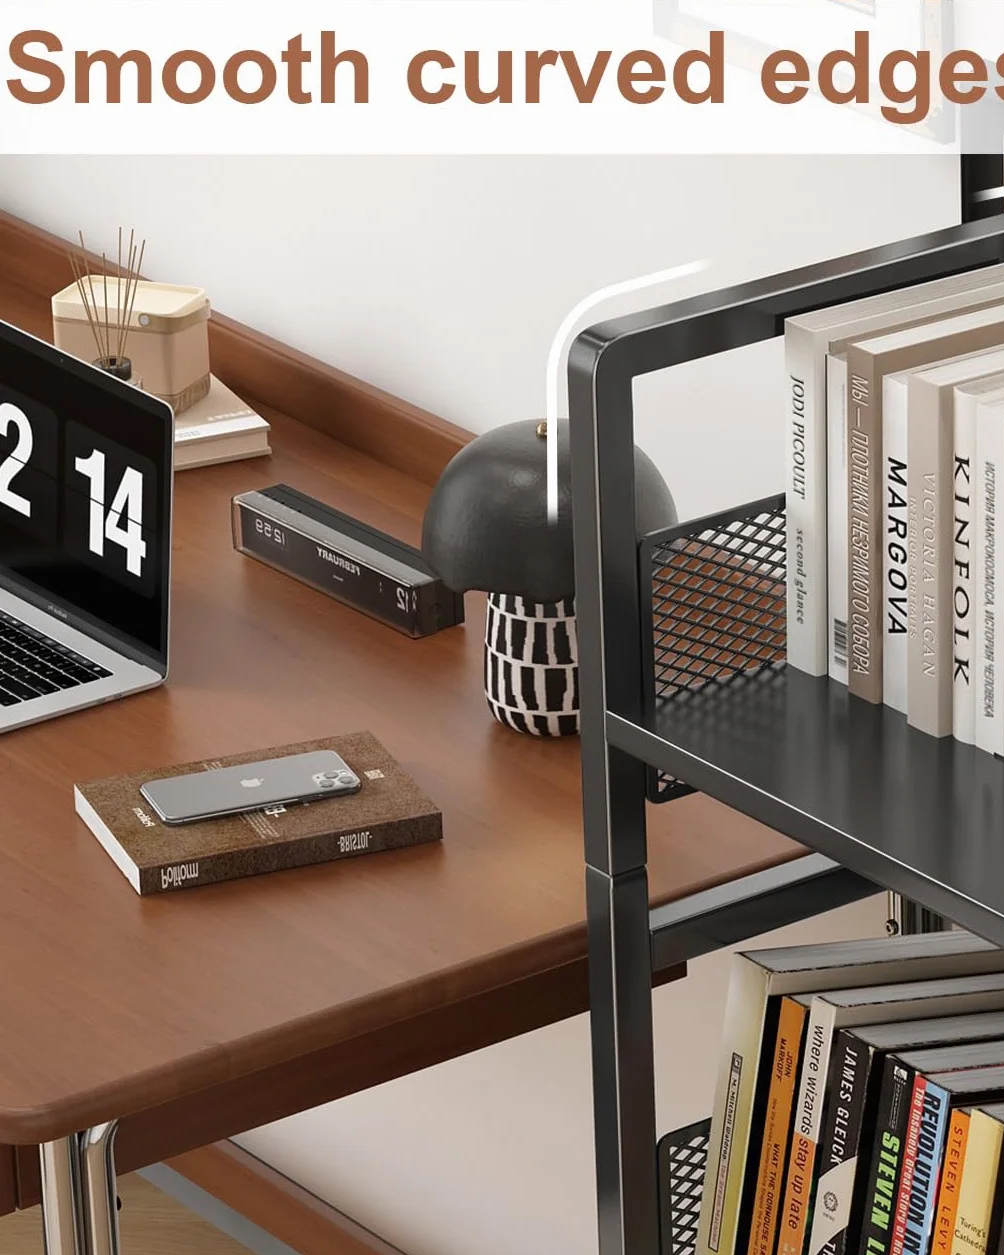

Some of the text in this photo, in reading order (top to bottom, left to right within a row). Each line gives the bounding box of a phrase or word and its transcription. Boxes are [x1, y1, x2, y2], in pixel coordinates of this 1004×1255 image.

[0, 402, 33, 518] 2
[789, 375, 806, 500] JODI PICOULT
[75, 449, 146, 577] 14
[851, 374, 870, 676] МЫ ПЛОТНИКИ НЕЗРИМОГО СОБОРА
[983, 461, 995, 513] ИСТОРИЯ
[793, 528, 807, 626] second glance
[887, 457, 908, 635] MARGOVA
[921, 472, 937, 678] VICTORIA HAGAN
[953, 454, 970, 686] KINFOLK
[983, 609, 995, 662] ИСТОРИЯ
[983, 663, 995, 719] ЧЕЛОВЕКА
[775, 1037, 787, 1083] MARKOFF
[785, 1051, 793, 1078] JOHN
[915, 1086, 925, 1107] The
[726, 1091, 736, 1126] Mitchell
[788, 1024, 825, 1231] where wizards stay up late
[830, 1046, 858, 1166] JAMES GLEICK
[907, 1108, 922, 1157] Insanely
[767, 1170, 776, 1189] THE
[770, 1143, 779, 1167] WHAT
[870, 1131, 900, 1231] STEVEN
[902, 1157, 915, 1191] Great
[905, 1092, 941, 1228] REVOLUTION
[938, 1126, 963, 1250] STEVEN LEVY
[898, 1191, 910, 1224] Story
[899, 1229, 922, 1255] IN
